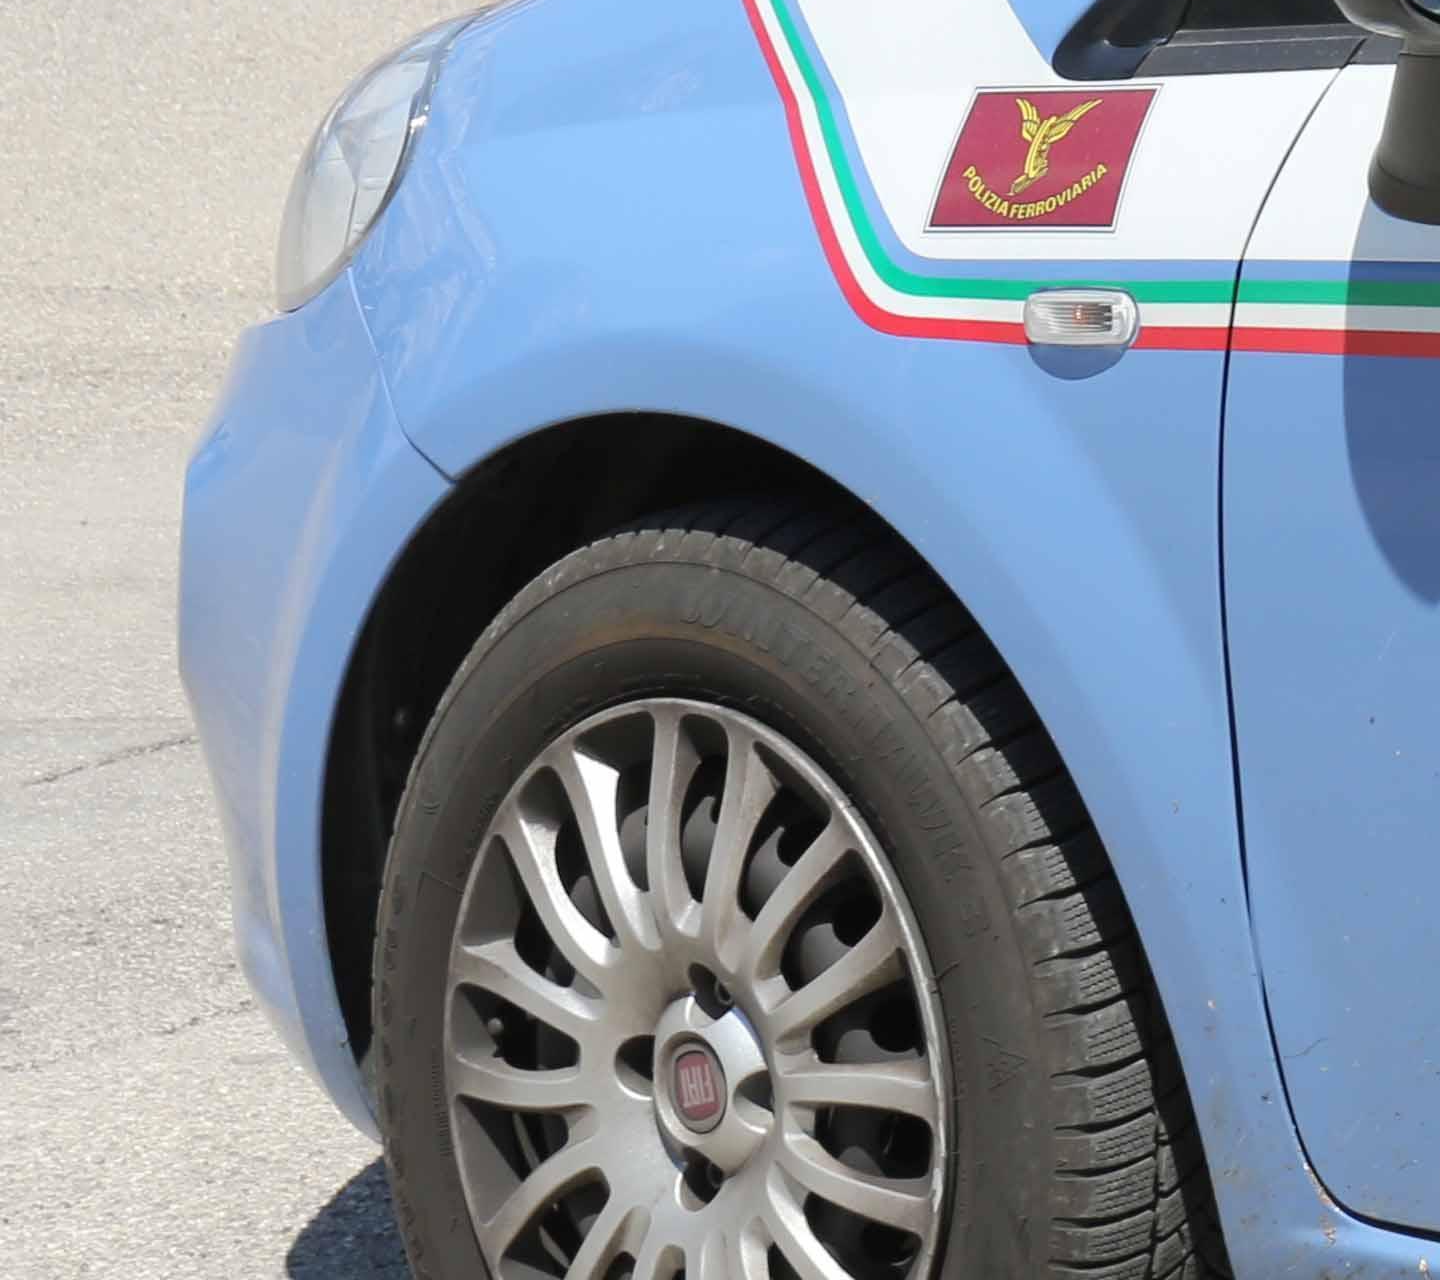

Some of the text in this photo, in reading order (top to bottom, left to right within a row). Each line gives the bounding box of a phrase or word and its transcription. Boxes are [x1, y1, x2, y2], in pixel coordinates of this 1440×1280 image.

[962, 163, 1108, 220] POLIZIA FERROVIARIA
[680, 1063, 716, 1108] FIAT
